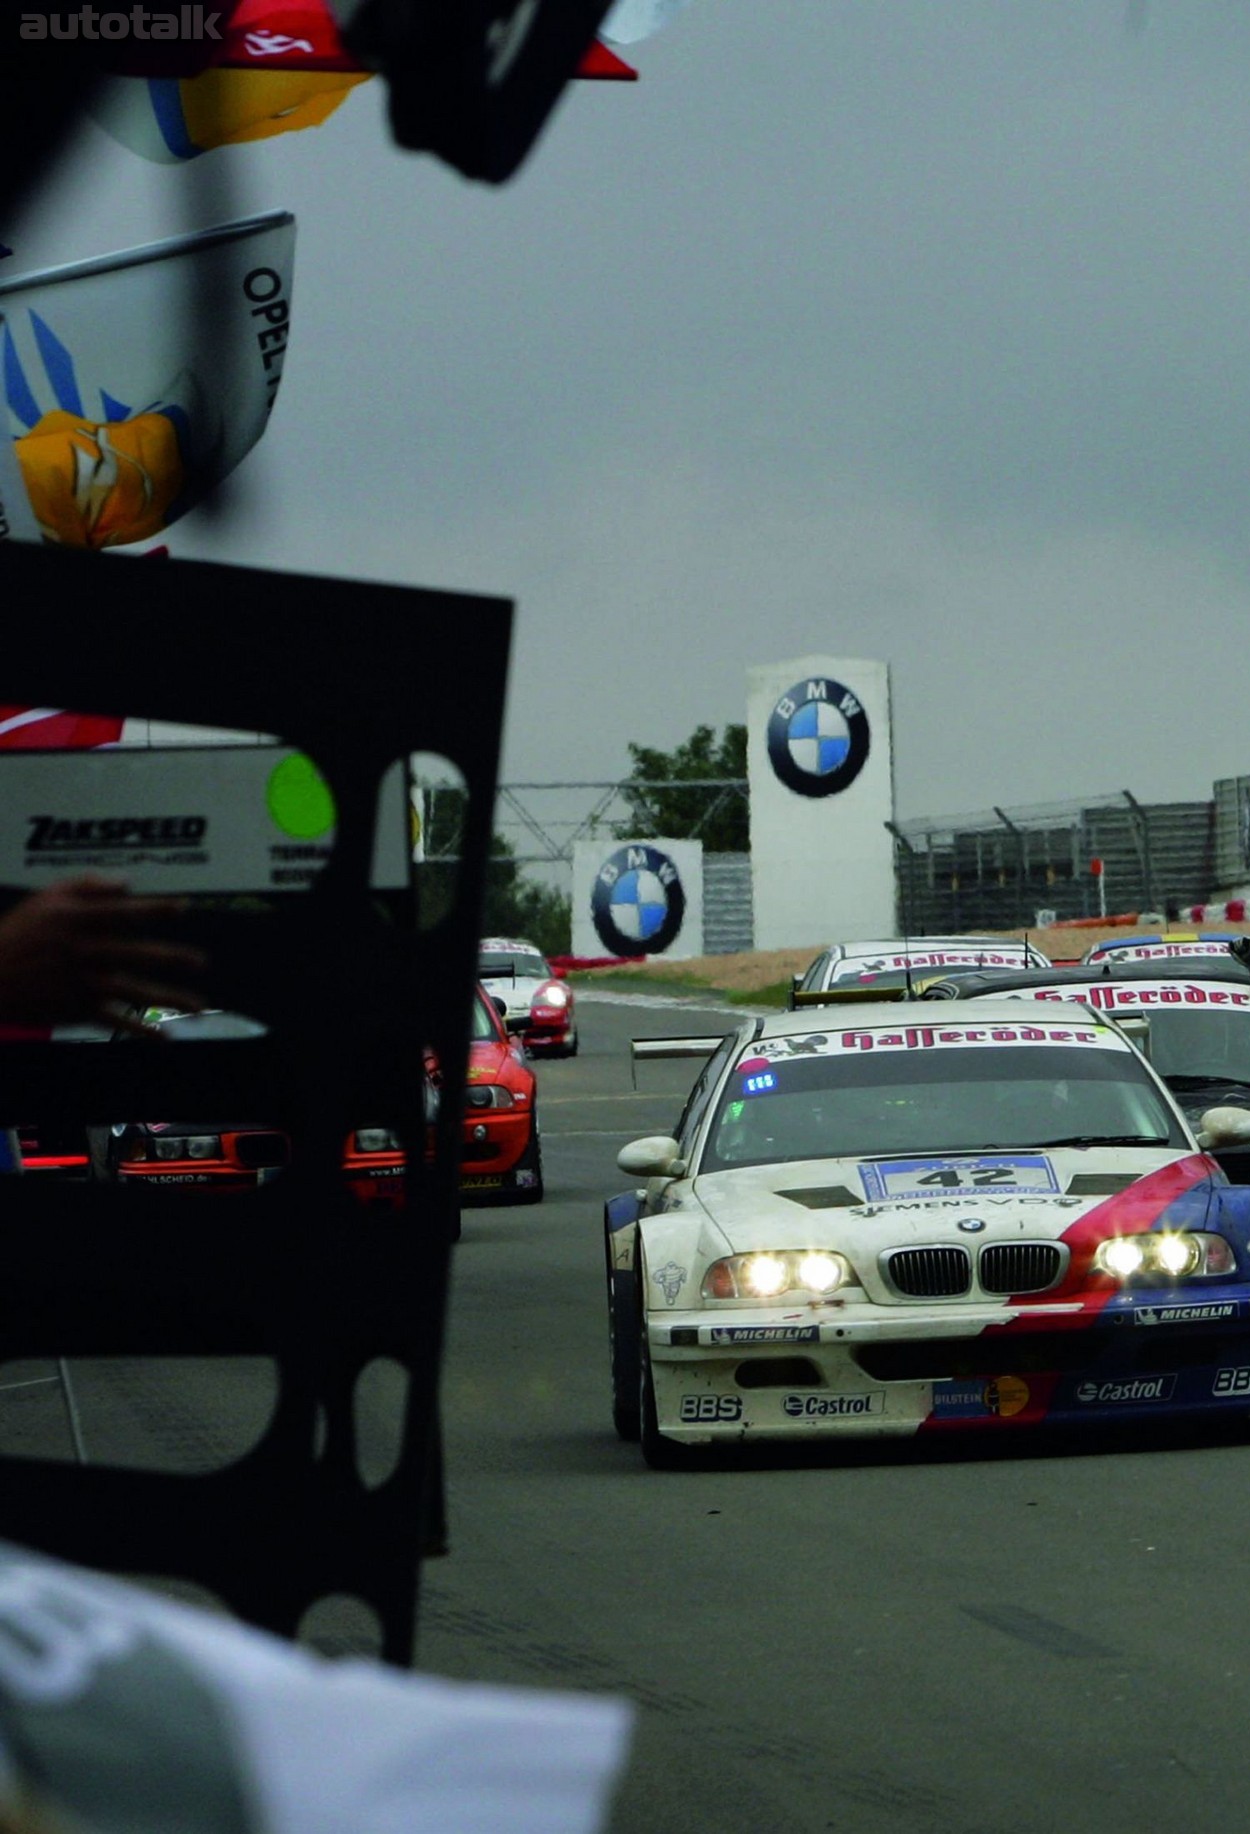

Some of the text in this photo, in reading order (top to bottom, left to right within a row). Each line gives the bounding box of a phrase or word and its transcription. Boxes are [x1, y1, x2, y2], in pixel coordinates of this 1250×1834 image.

[242, 266, 291, 370] OPEL
[776, 680, 861, 719] BMW
[25, 815, 208, 851] ZAKSPEED
[600, 849, 680, 886] BMW
[1135, 944, 1231, 959] Hasseröd
[841, 1025, 1098, 1050] Hasseröder
[916, 1168, 1018, 1187] 42
[850, 1198, 979, 1217] SIEMENS
[1160, 1304, 1234, 1320] MICHELIN
[733, 1327, 813, 1341] MICHELIN
[1099, 1378, 1163, 1401] Castrol
[680, 1393, 744, 1423] BBS
[805, 1395, 873, 1416] Castrol
